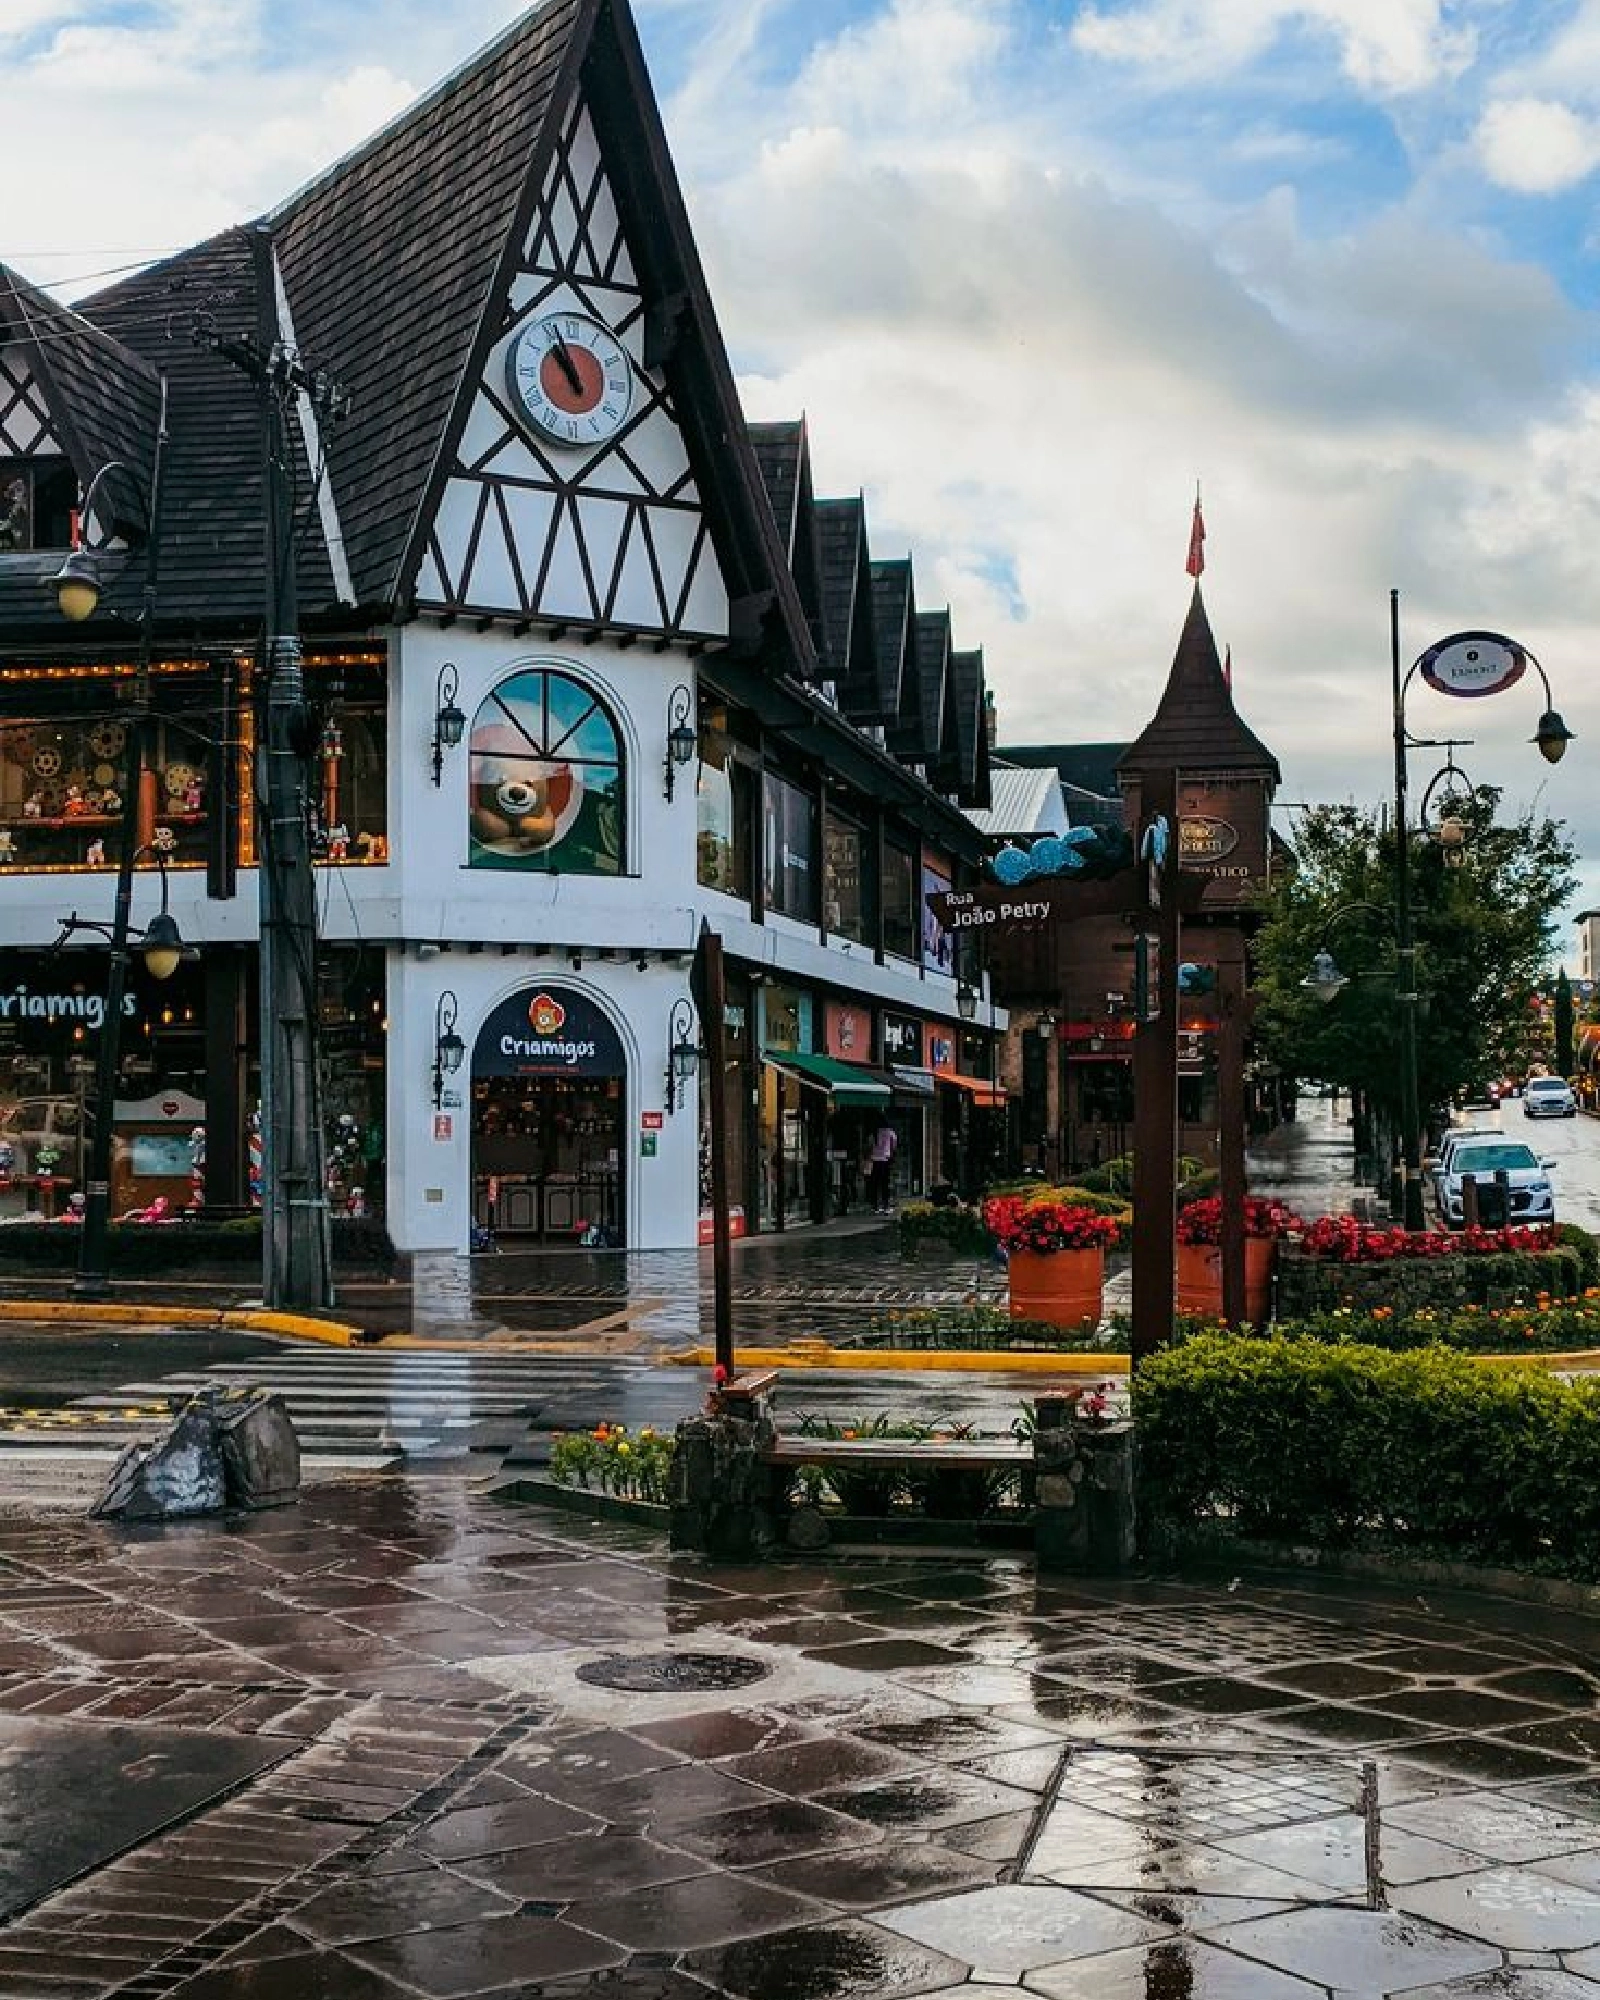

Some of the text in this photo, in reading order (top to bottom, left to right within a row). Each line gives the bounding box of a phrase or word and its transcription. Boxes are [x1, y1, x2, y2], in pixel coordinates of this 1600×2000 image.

[946, 892, 974, 906] Rua
[952, 901, 1050, 927] João Petry
[0, 985, 137, 1028] riamigs
[500, 1035, 595, 1064] Criamigos
